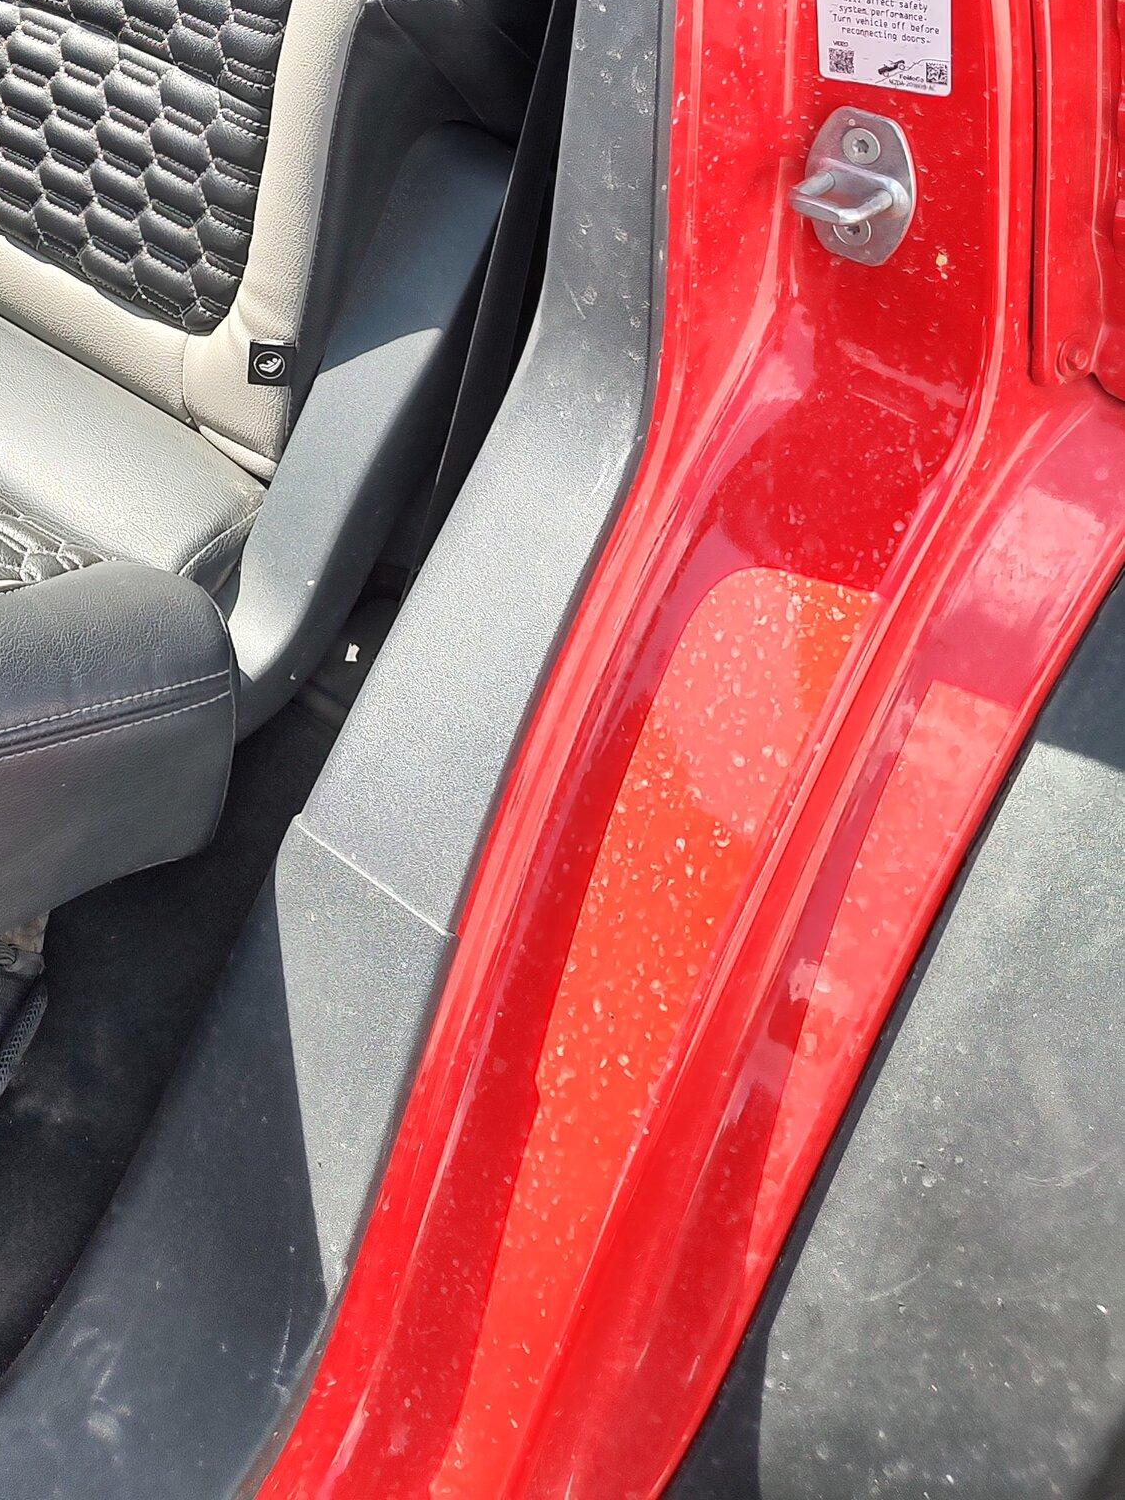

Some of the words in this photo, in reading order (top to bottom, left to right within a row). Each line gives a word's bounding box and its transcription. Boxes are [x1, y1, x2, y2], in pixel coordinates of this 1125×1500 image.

[838, 5, 867, 14] system
[871, 8, 927, 22] performance.
[899, 1, 928, 12] safety
[832, 13, 852, 23] Turn
[855, 17, 888, 28] vehicle
[891, 21, 905, 31] off
[910, 24, 940, 35] before
[841, 26, 897, 42] reconnecting
[901, 33, 931, 44] doors.
